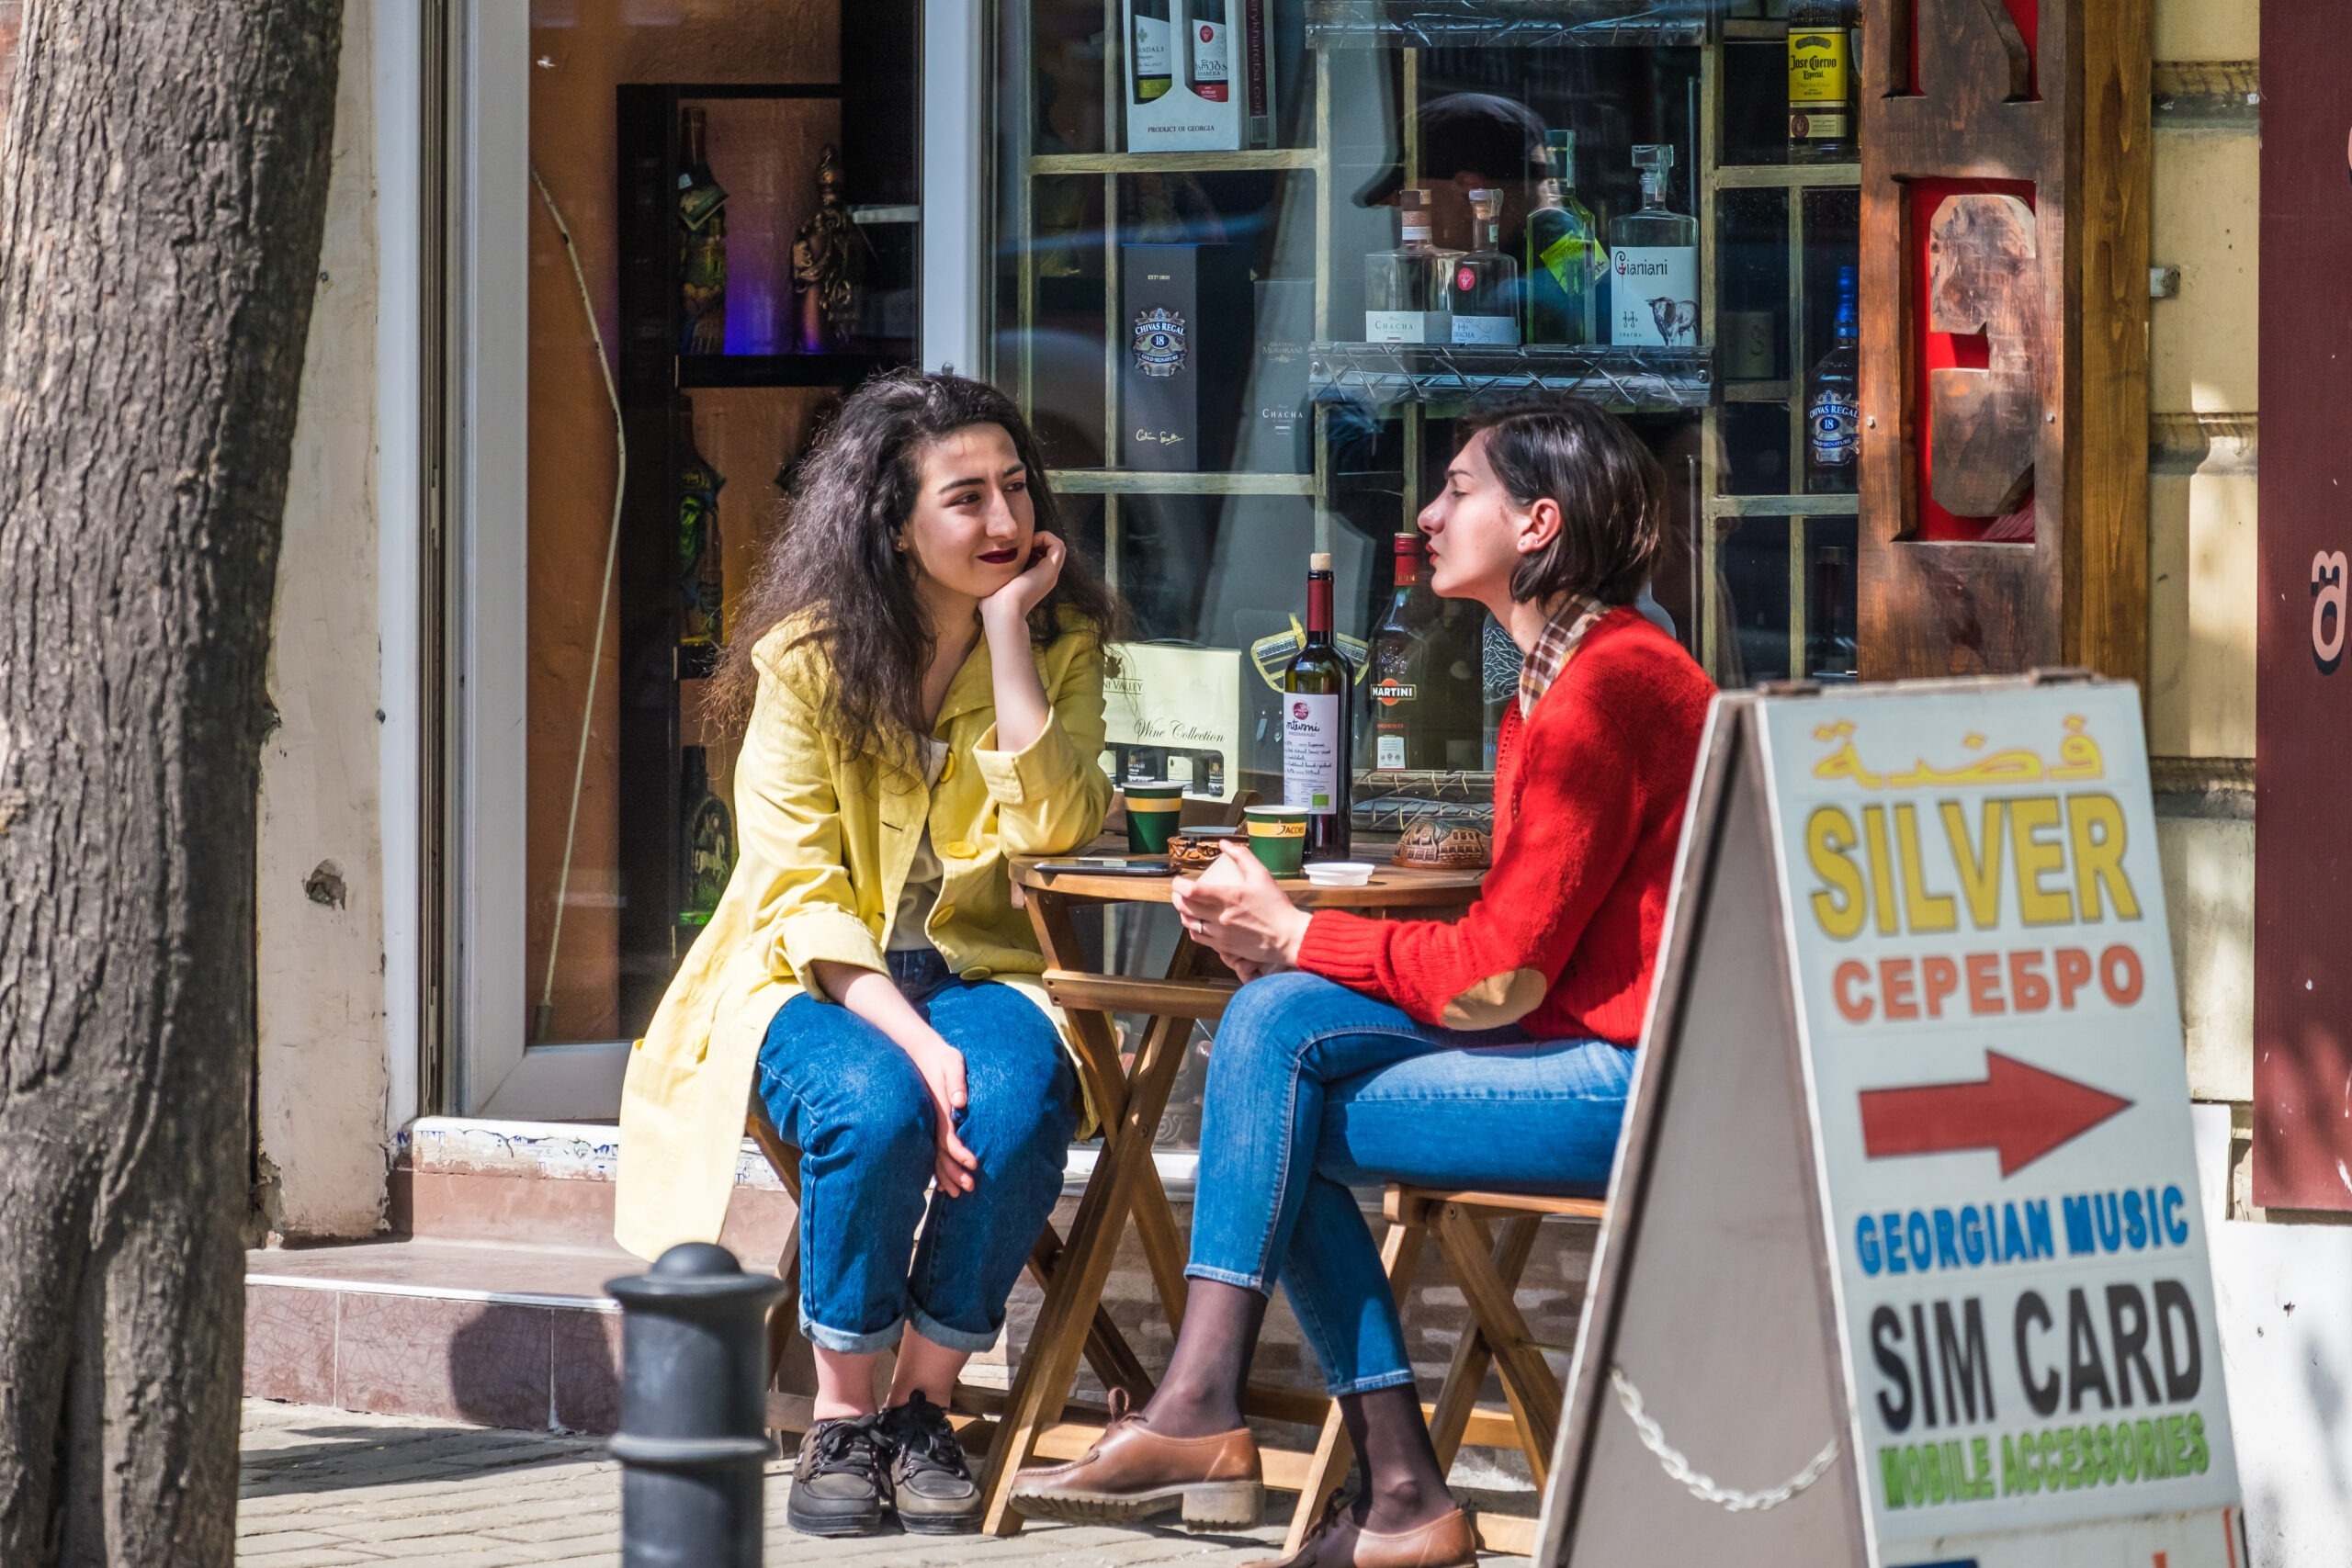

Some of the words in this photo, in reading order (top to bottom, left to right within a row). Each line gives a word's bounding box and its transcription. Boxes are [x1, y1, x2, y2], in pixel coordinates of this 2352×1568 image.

[1790, 54, 1808, 71] Jose
[1809, 54, 1837, 71] Cuervo
[1135, 322, 1159, 335] CHIVAS
[1161, 322, 1185, 336] REGAL
[1156, 335, 1165, 345] 18
[1262, 408, 1303, 419] CHACHA
[1809, 405, 1829, 419] CHIVAS
[1831, 405, 1859, 419] REGAL
[1824, 419, 1834, 430] 18
[1113, 680, 1143, 692] VALLEY
[1372, 686, 1413, 697] MARTINI
[1134, 717, 1165, 738] Wine
[1170, 720, 1225, 743] Collection
[1804, 791, 2143, 942] SILVER
[1832, 943, 2145, 1023] СЕРЕБРО
[1855, 1199, 2056, 1278] GEORGIAN
[2064, 1184, 2189, 1257] MUSIC
[1870, 1296, 1996, 1434] SIM
[2014, 1278, 2204, 1417] CARD
[1877, 1431, 1996, 1511] MOBILE
[2000, 1411, 2211, 1496] ACCESSORIES
